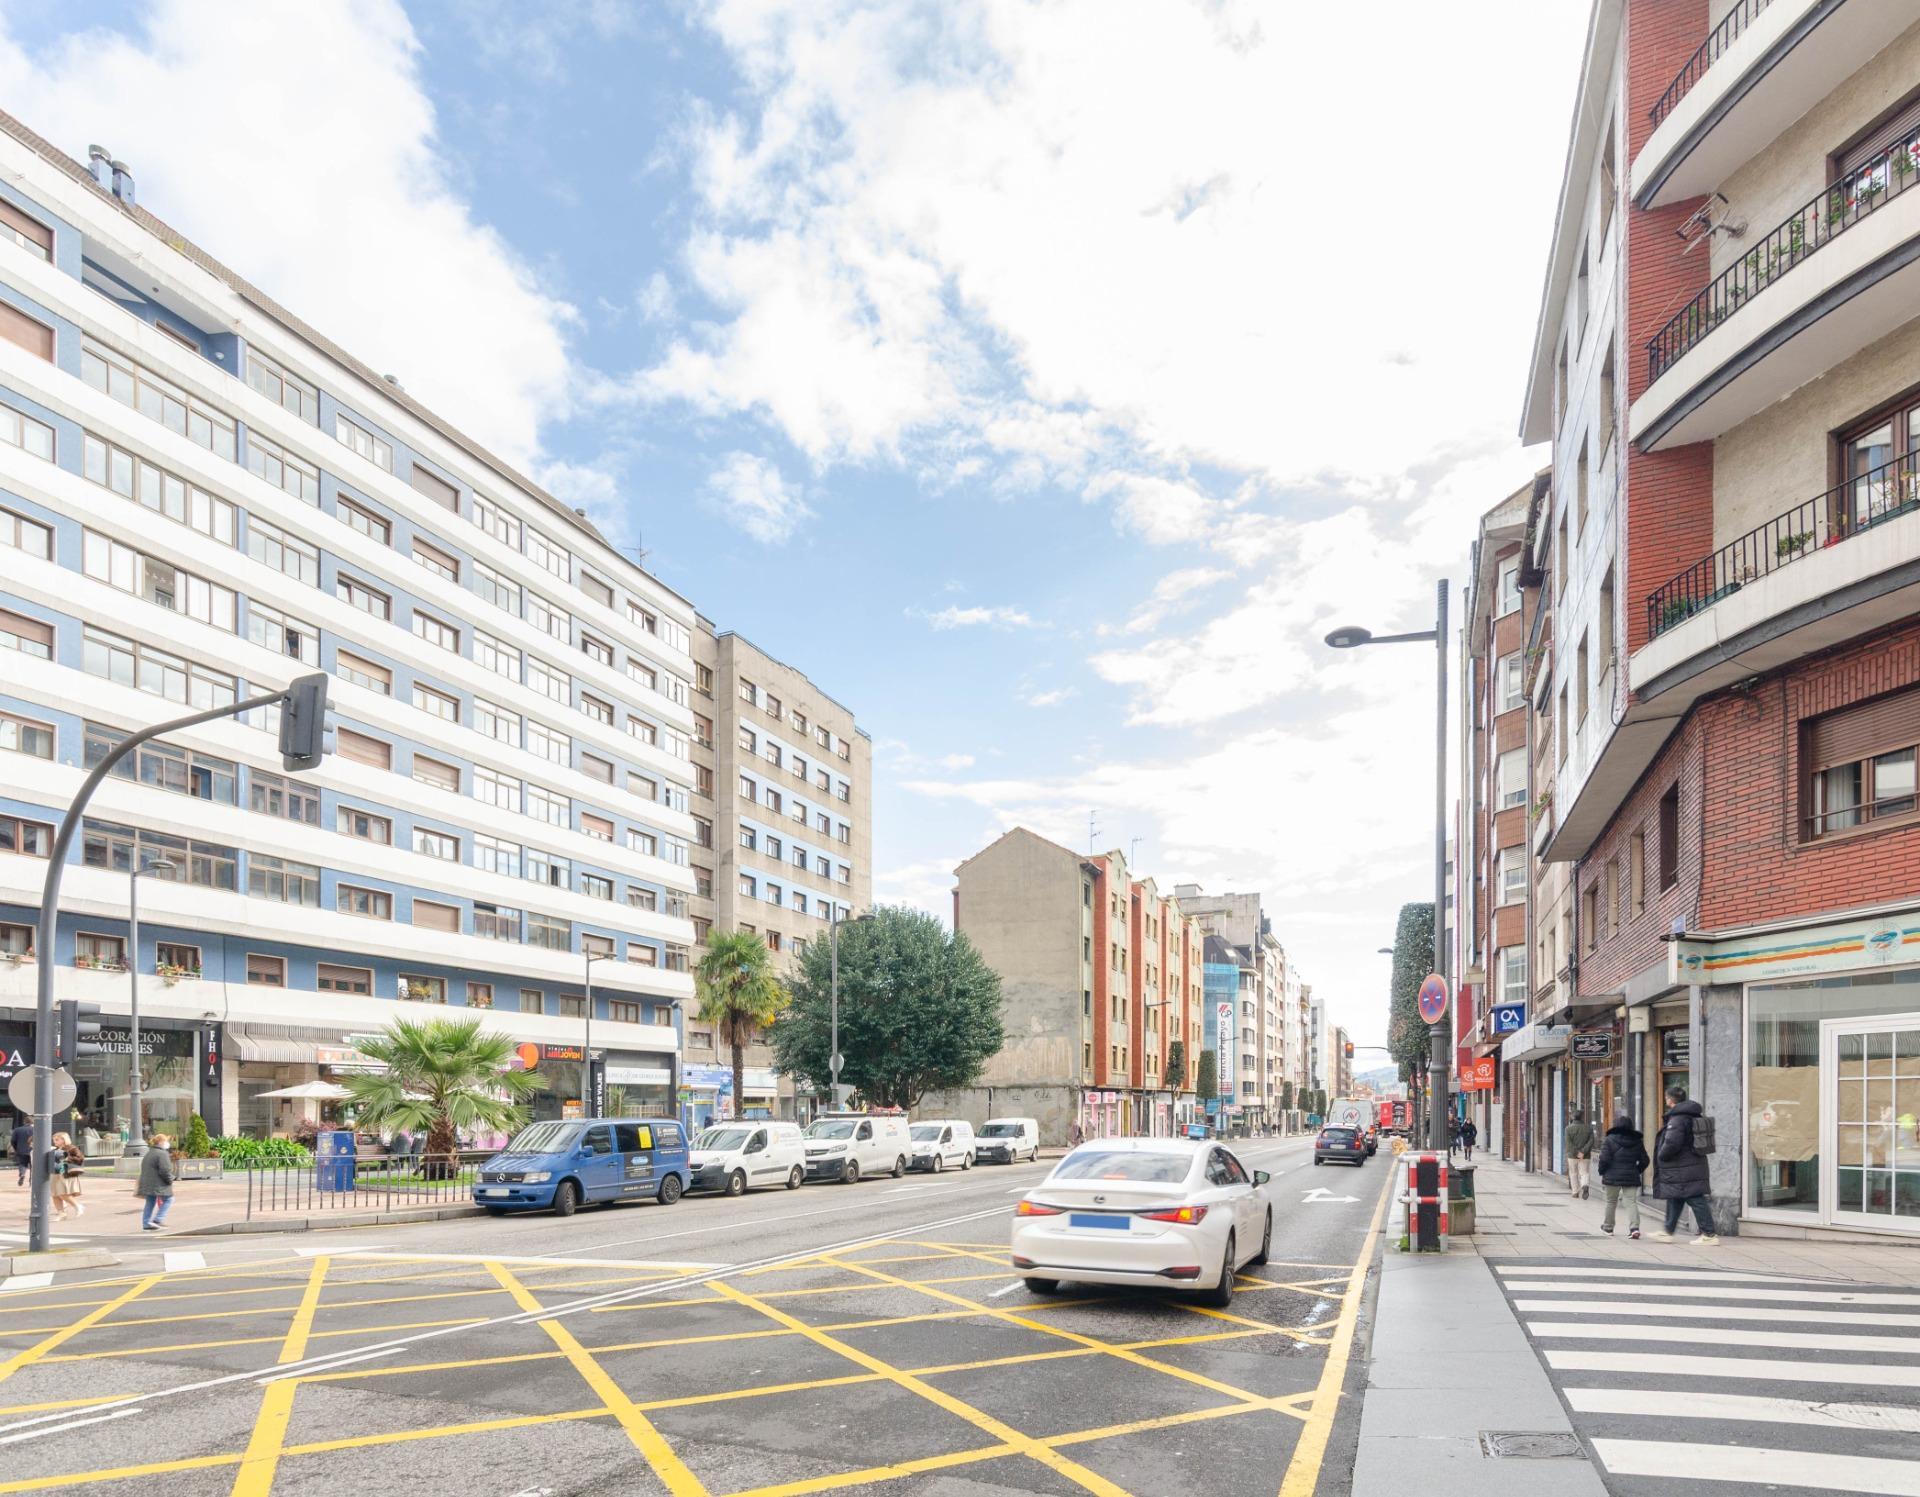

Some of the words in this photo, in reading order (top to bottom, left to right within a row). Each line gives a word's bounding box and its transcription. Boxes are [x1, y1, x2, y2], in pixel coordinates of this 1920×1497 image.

[96, 1041, 153, 1055] MUEBES
[208, 1030, 217, 1076] FHOA
[597, 1095, 603, 1106] DE
